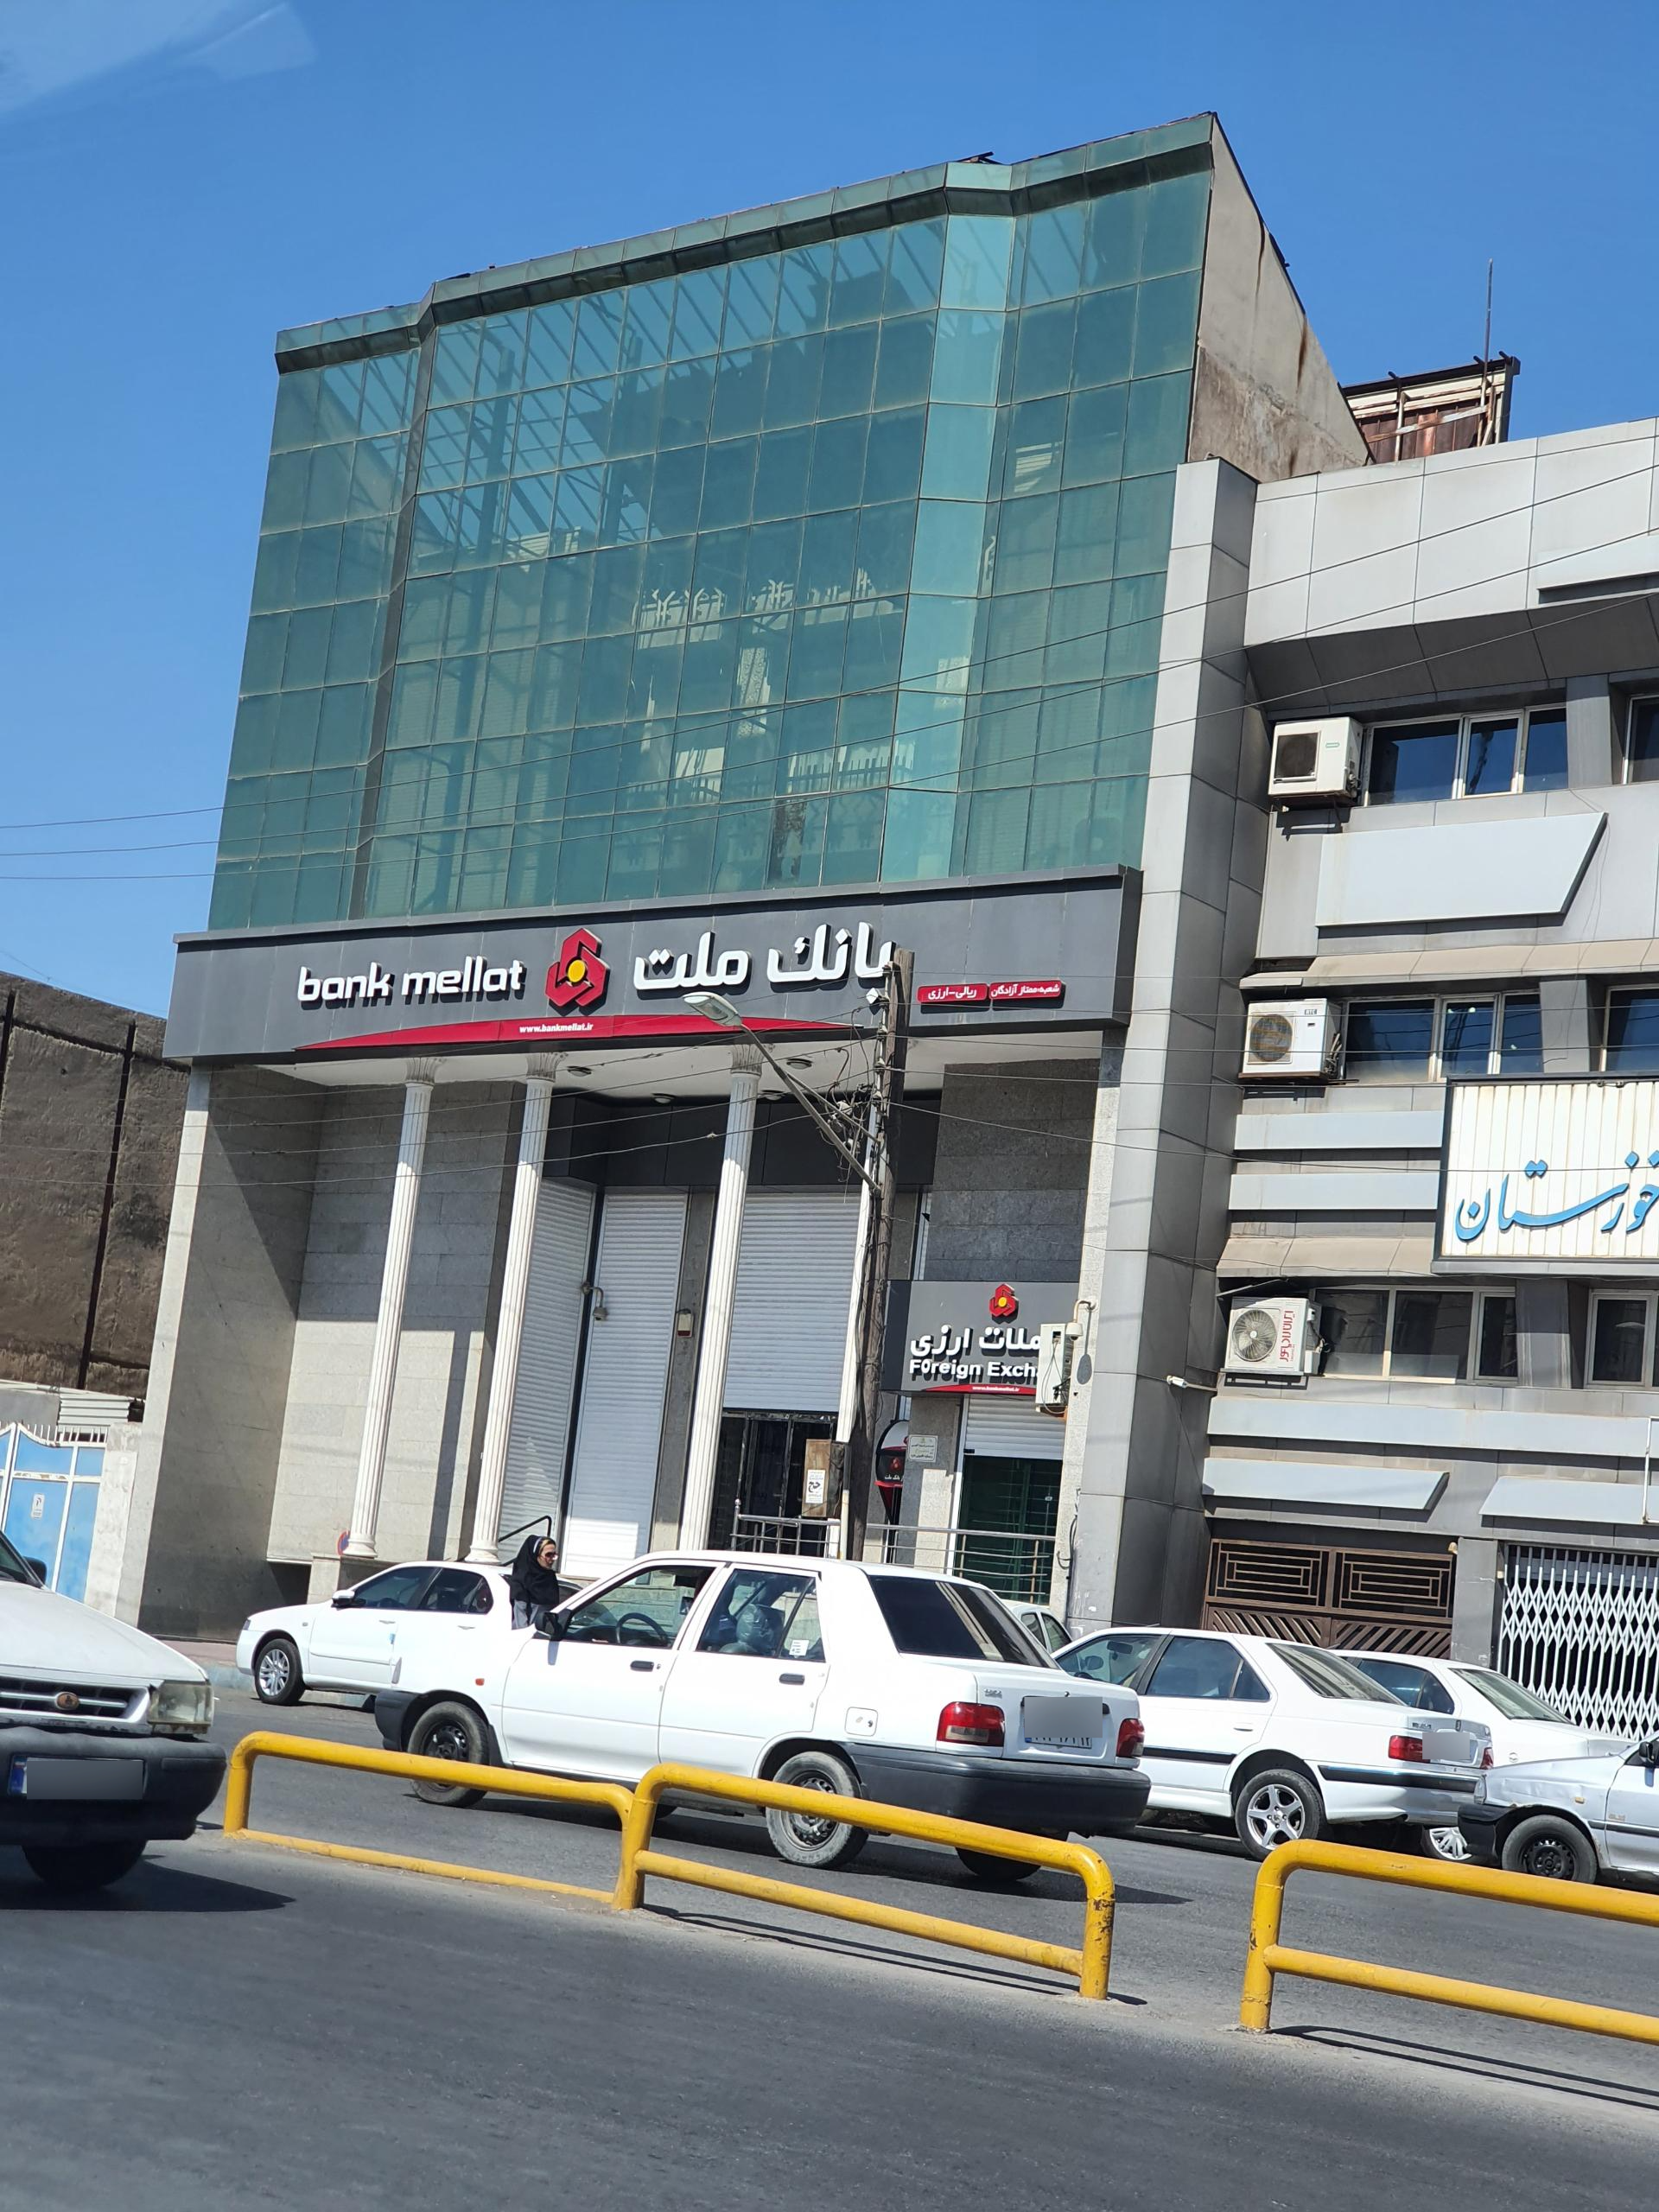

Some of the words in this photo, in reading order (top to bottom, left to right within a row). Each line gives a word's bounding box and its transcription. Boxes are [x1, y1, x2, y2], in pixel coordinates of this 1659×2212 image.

[633, 931, 749, 990] ملت
[297, 962, 390, 1001] bank
[402, 956, 523, 995] mellat
[990, 984, 1018, 997] آزادگان
[519, 1023, 594, 1033] www.bankmellat.ir
[910, 1325, 969, 1357] ارزی
[979, 1326, 1040, 1350] ملات
[988, 1362, 1039, 1377] Exch
